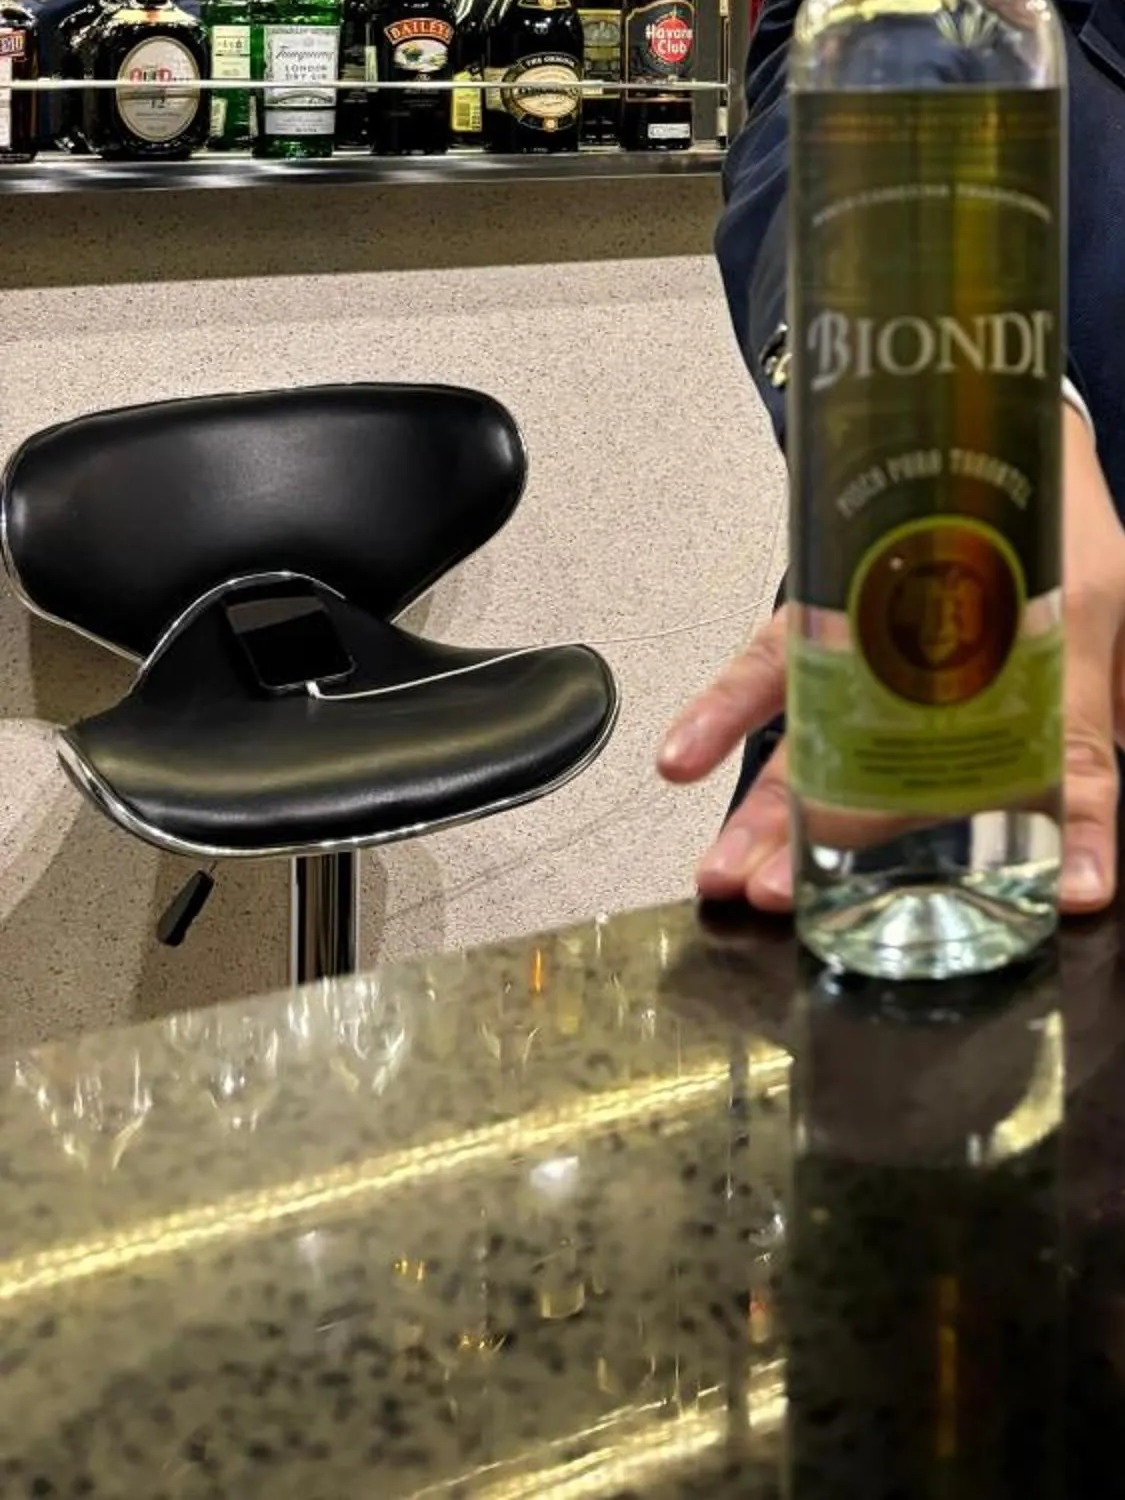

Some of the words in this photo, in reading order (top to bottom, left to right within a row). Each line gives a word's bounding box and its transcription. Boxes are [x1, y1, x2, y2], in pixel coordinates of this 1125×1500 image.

[645, 23, 694, 40] Havana
[657, 39, 688, 54] Club
[806, 308, 1054, 393] BIONDI
